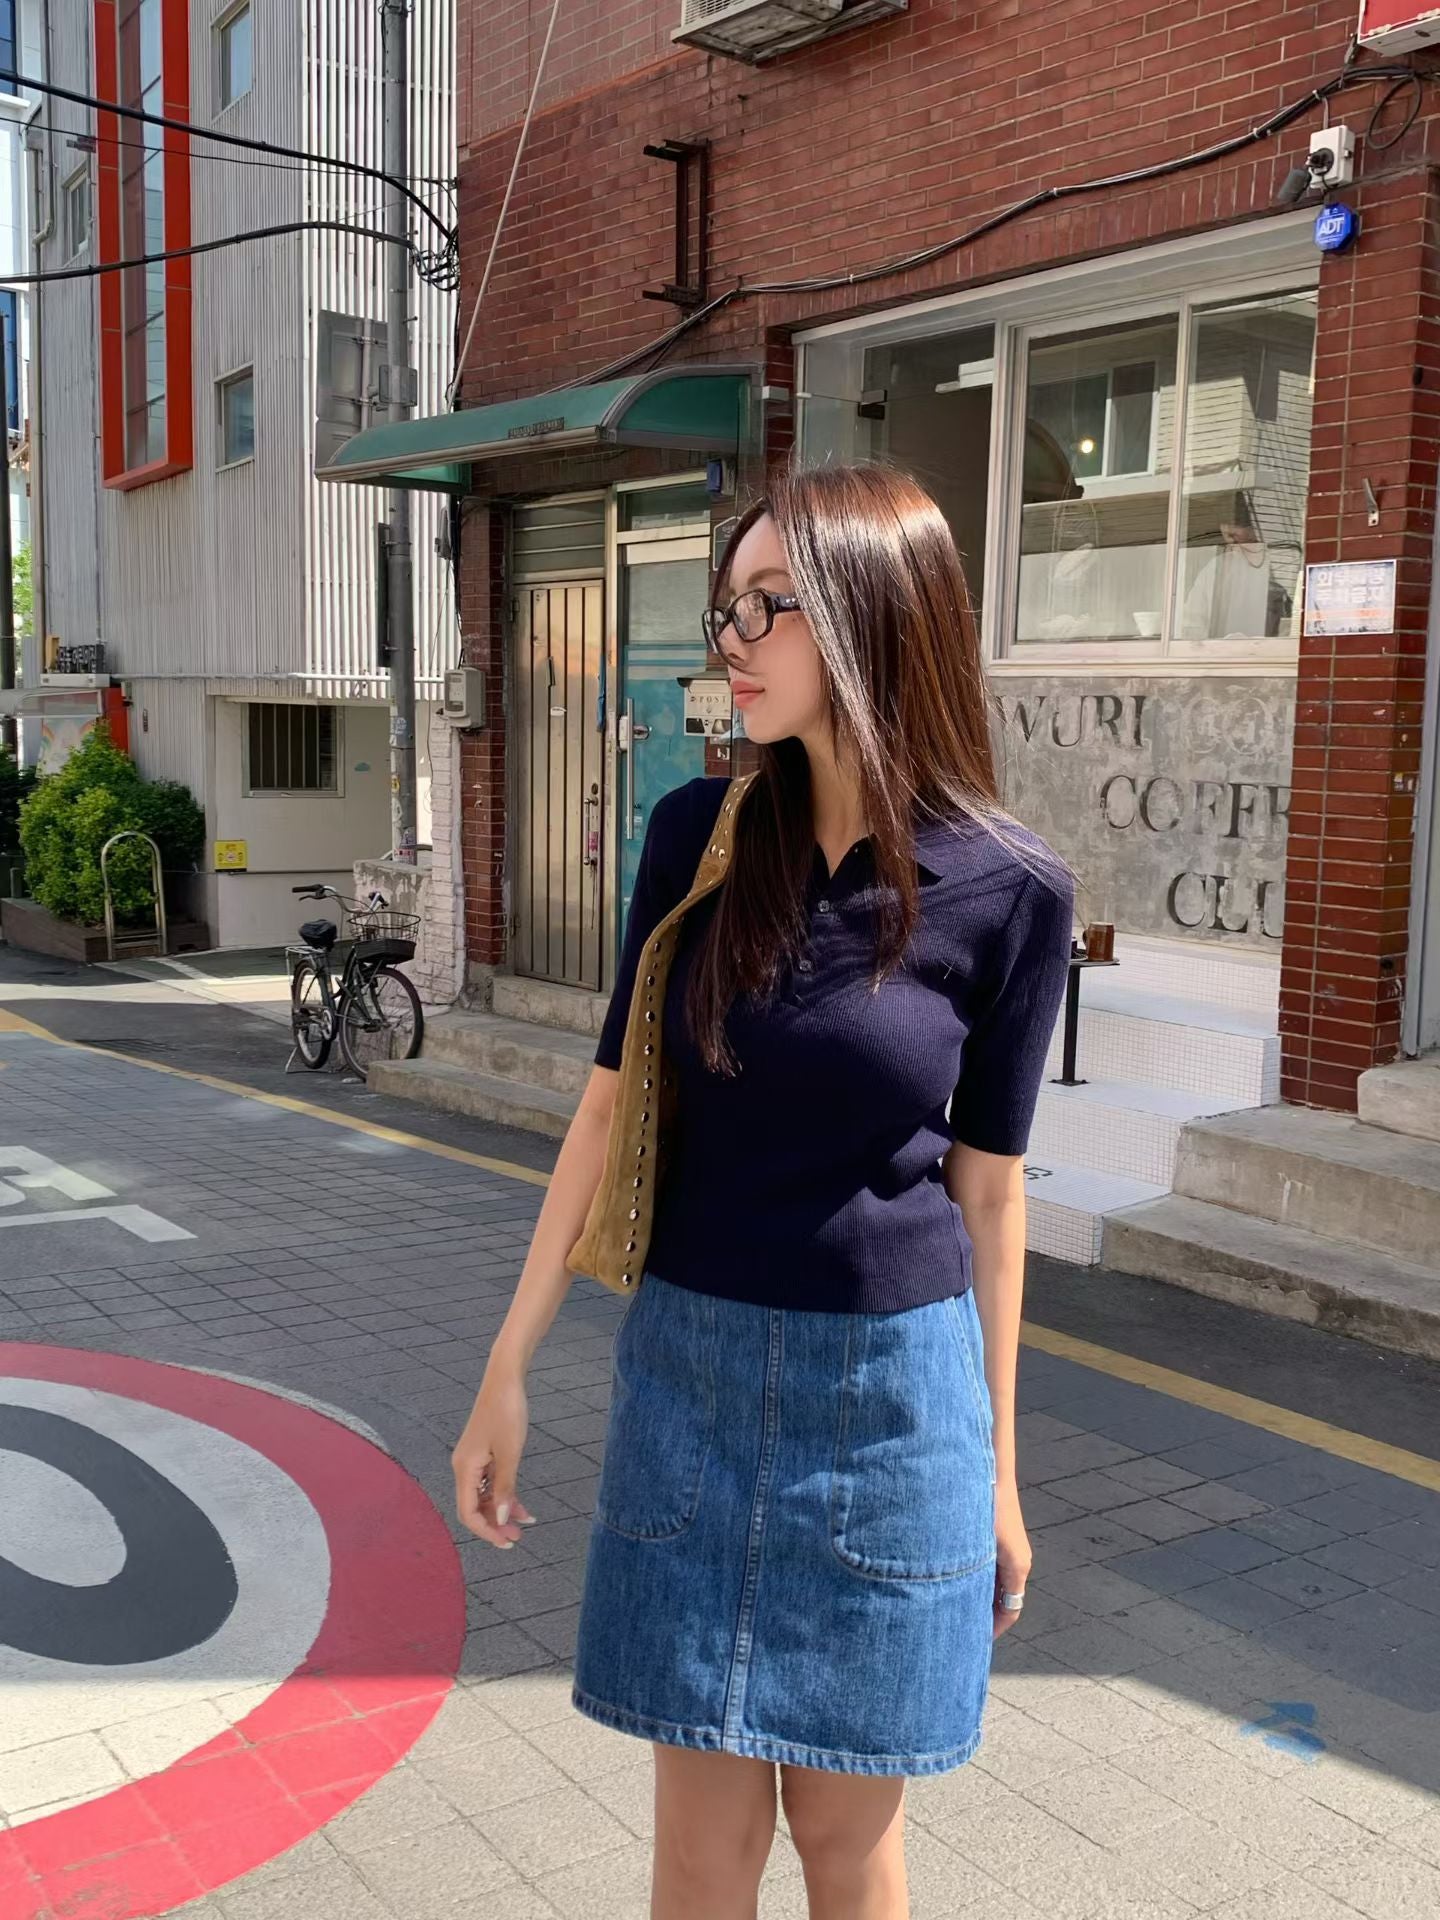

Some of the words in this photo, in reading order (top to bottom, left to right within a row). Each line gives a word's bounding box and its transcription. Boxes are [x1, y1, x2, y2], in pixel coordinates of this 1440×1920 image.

[1319, 216, 1345, 235] ADT
[697, 695, 727, 703] POST
[995, 695, 1147, 749] WURI
